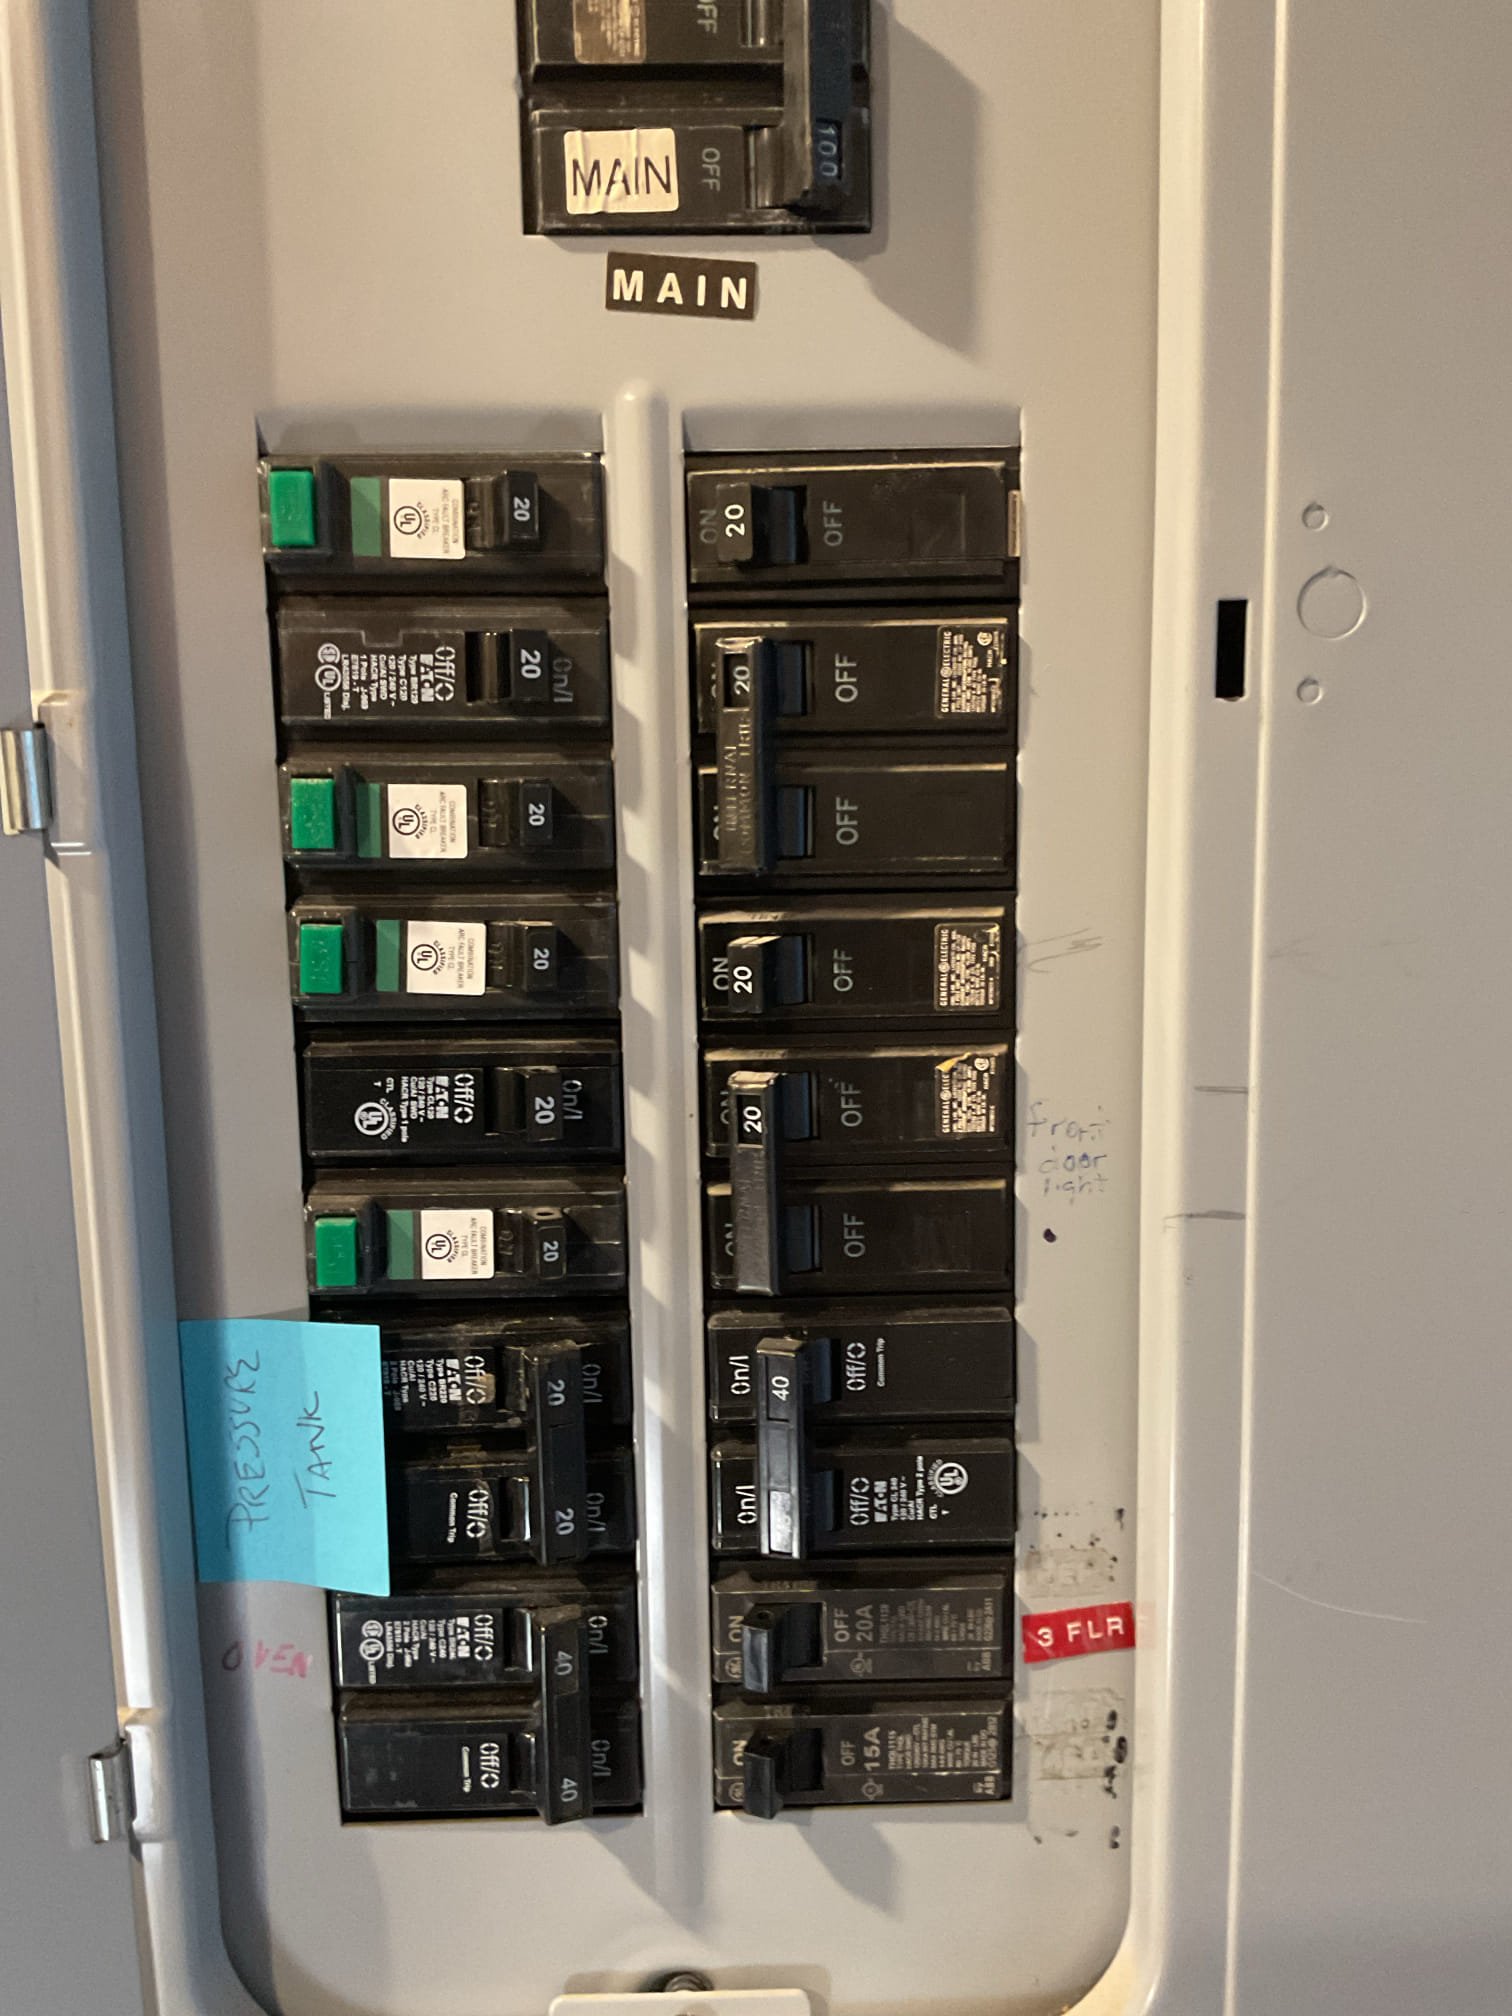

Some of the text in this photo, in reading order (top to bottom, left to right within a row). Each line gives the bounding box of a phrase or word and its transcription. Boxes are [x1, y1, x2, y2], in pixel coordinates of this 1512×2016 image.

[696, 0, 717, 34] FF
[816, 127, 838, 178] 100
[572, 155, 672, 197] MAIN
[702, 148, 721, 191] OFF
[612, 269, 747, 309] MAIN
[400, 513, 415, 527] UL
[514, 497, 530, 521] 20
[725, 504, 745, 538] 20
[700, 509, 718, 545] ON
[823, 501, 843, 546] OFF
[410, 655, 418, 674] Type
[521, 649, 541, 679] 20
[941, 631, 952, 712] GENERAL ELECTRIC
[322, 671, 335, 685] UL
[370, 682, 378, 701] Type
[734, 665, 750, 695] 20
[835, 653, 858, 703] OFF
[399, 815, 413, 828] UL
[529, 802, 545, 827] 20
[836, 797, 859, 845] OFF
[417, 951, 432, 963] UL
[533, 948, 549, 970] 20
[833, 949, 853, 992] OFF
[939, 929, 948, 1006] GENERAL ELECTRIC
[734, 966, 752, 994] 20
[386, 1077, 394, 1093] CTL
[400, 1101, 408, 1118] Type
[535, 1097, 555, 1125] 20
[841, 1082, 863, 1128] OFF
[942, 1101, 950, 1133] GENERAL
[362, 1111, 382, 1128] UL
[380, 1098, 397, 1140] CLASSIFIED
[744, 1106, 762, 1133] 20
[431, 1241, 446, 1253] UL
[844, 1214, 865, 1258] OFF
[543, 1241, 559, 1262] 20
[426, 1359, 435, 1378] Type
[436, 1359, 445, 1376] Type
[876, 1338, 886, 1387] Common Trip
[401, 1385, 409, 1402] Type
[547, 1379, 566, 1406] 20
[772, 1375, 789, 1400] 40
[293, 1391, 337, 1508] TANK
[916, 1479, 924, 1496] Type
[940, 1469, 959, 1486] UL
[446, 1492, 458, 1543] Common Trip
[555, 1508, 574, 1535] 20
[437, 1619, 445, 1637] Type
[834, 1607, 850, 1642] OFF
[856, 1605, 873, 1642] 20A
[1037, 1617, 1124, 1647] 3 FLR
[412, 1644, 420, 1660] Type
[554, 1651, 572, 1676] 40
[841, 1740, 856, 1765] OFF
[863, 1727, 881, 1771] 15A
[463, 1778, 473, 1792] Trip
[560, 1778, 578, 1802] 40
[984, 1776, 995, 1795] ABB
